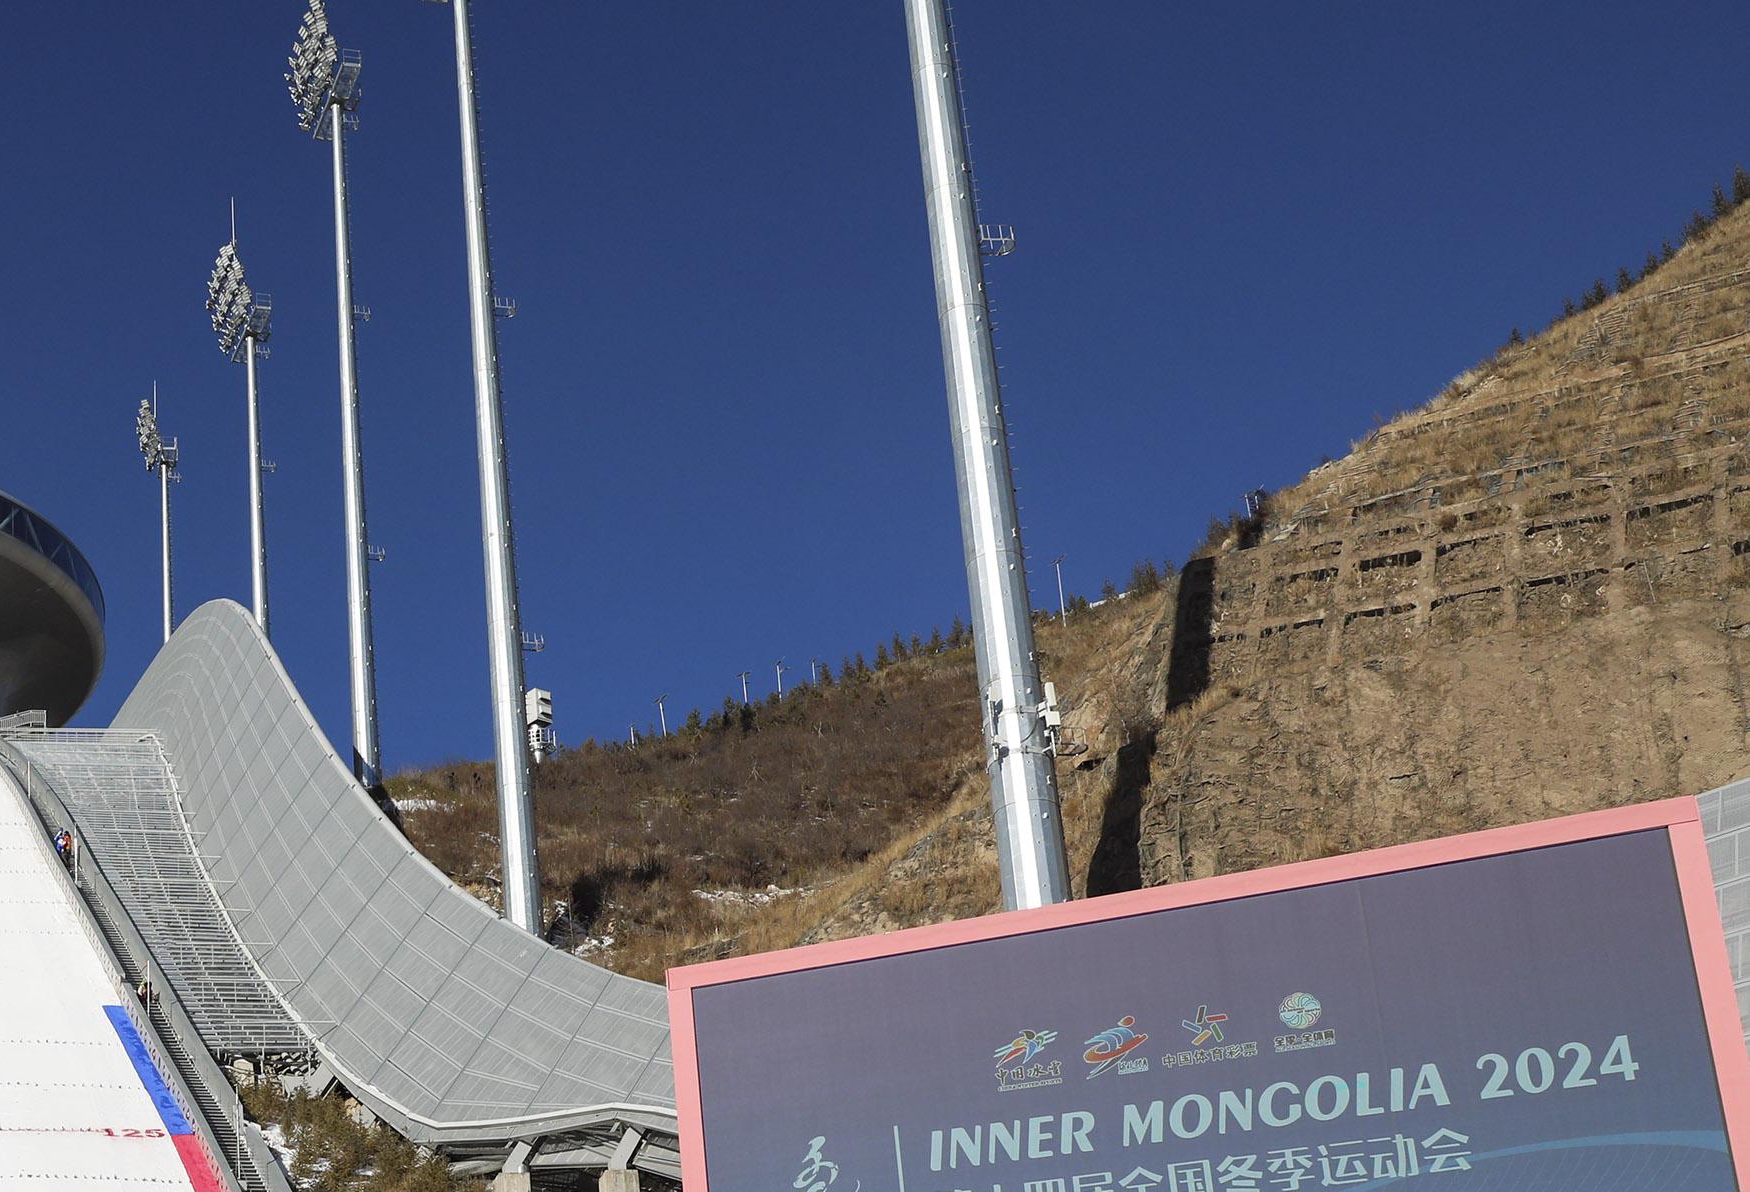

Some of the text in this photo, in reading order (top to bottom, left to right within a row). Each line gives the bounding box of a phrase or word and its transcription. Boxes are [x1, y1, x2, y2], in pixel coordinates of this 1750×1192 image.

[1162, 1042, 1258, 1068] 中国体育彩票
[930, 1035, 1639, 1172] INNER MONGOLIA 2024
[103, 1128, 166, 1138] 125
